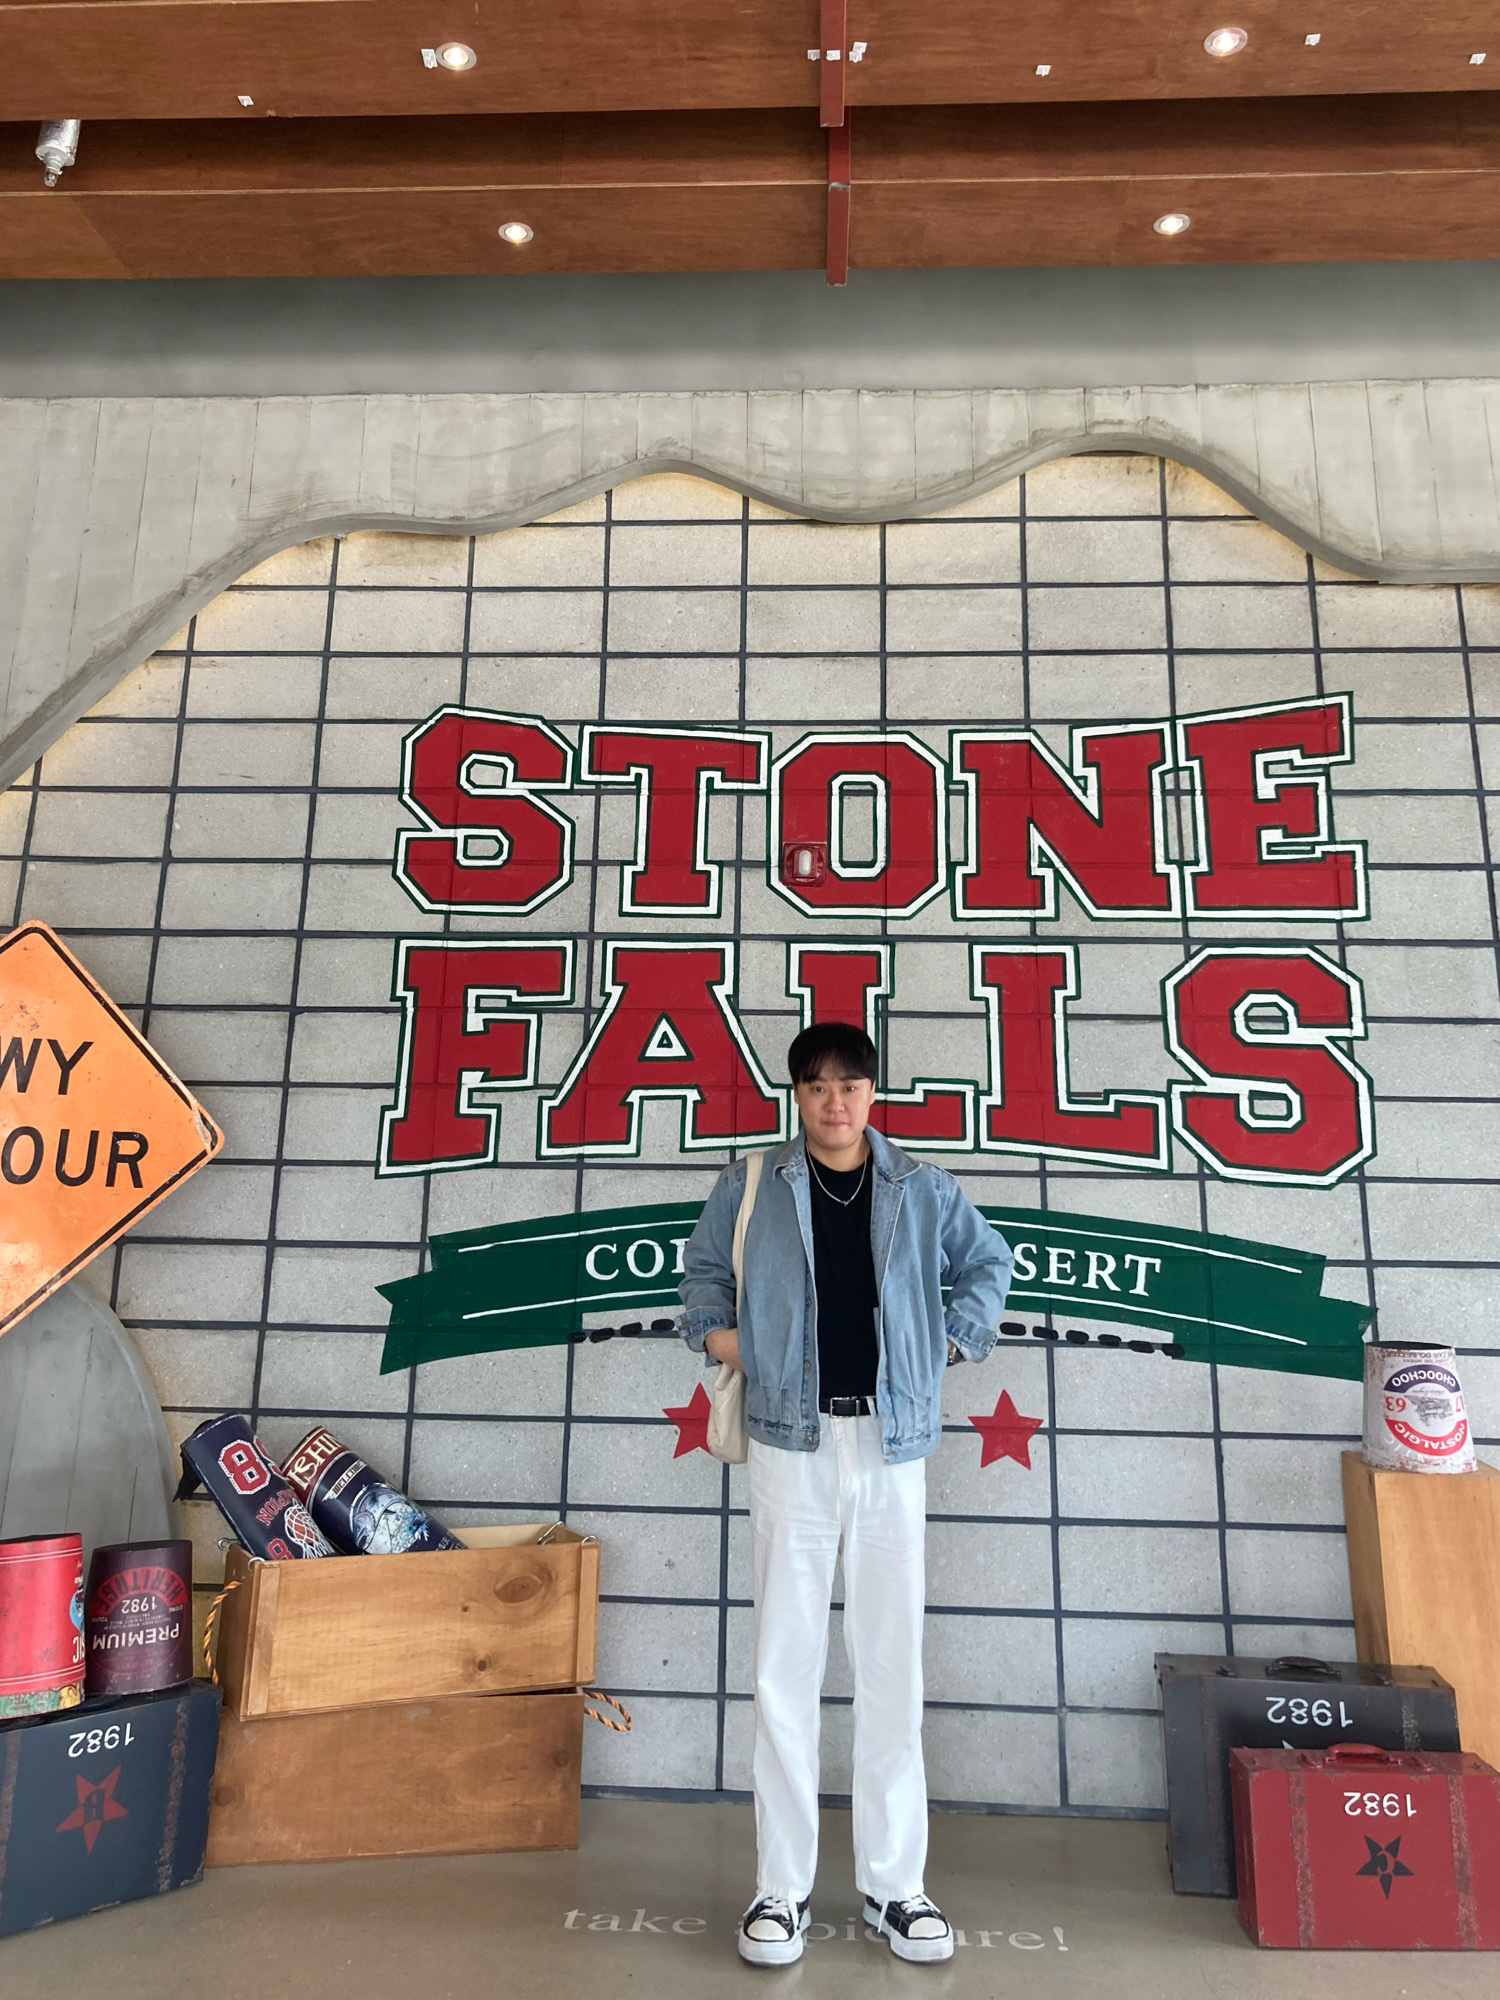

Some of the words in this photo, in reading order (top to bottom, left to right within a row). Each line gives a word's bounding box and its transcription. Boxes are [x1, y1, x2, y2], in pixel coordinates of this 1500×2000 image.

[392, 691, 1371, 921] STONE
[376, 938, 1377, 1188] FALLS
[1, 1126, 149, 1188] OUR
[1391, 1370, 1456, 1388] CHOOCHOO
[1385, 1396, 1407, 1413] 63
[1394, 1423, 1466, 1450] NOSTALGIC
[121, 1596, 158, 1614] 1982
[92, 1622, 180, 1650] PREMIUM
[1266, 1697, 1353, 1728] 1982
[68, 1722, 135, 1758] 1982
[1343, 1792, 1417, 1817] 1982
[563, 1908, 707, 1935] take
